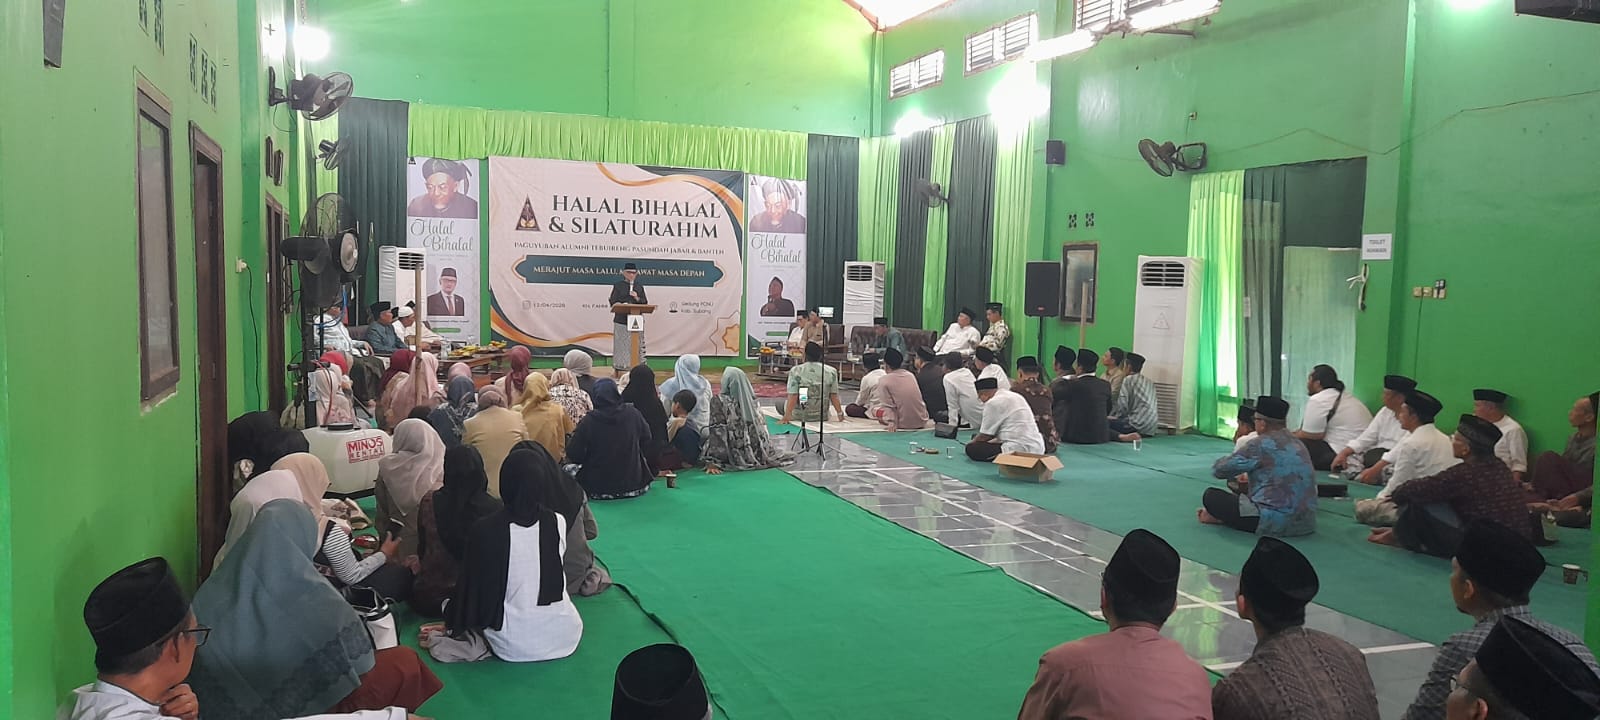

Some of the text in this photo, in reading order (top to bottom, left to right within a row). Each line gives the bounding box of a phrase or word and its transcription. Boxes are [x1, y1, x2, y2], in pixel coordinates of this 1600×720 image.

[552, 195, 720, 219] HALAL BIHALAL
[410, 218, 454, 236] Halal
[548, 215, 718, 239] & SILATURAHIM
[423, 234, 473, 251] Bihalal
[514, 241, 559, 250] PAGUYUBAN
[560, 243, 589, 251] ALUMNI
[591, 244, 630, 252] TEBUIRENG
[632, 246, 669, 254] PASUNDAN
[751, 233, 786, 249] Halal
[760, 248, 801, 263] Bihalal
[533, 265, 571, 274] MERAJUT
[572, 266, 594, 274] MASA
[595, 267, 619, 275] LALU,
[657, 268, 679, 276] MASA
[679, 269, 705, 277] DEPAN
[348, 438, 383, 453] MINOS
[350, 447, 383, 459] RENTAL
